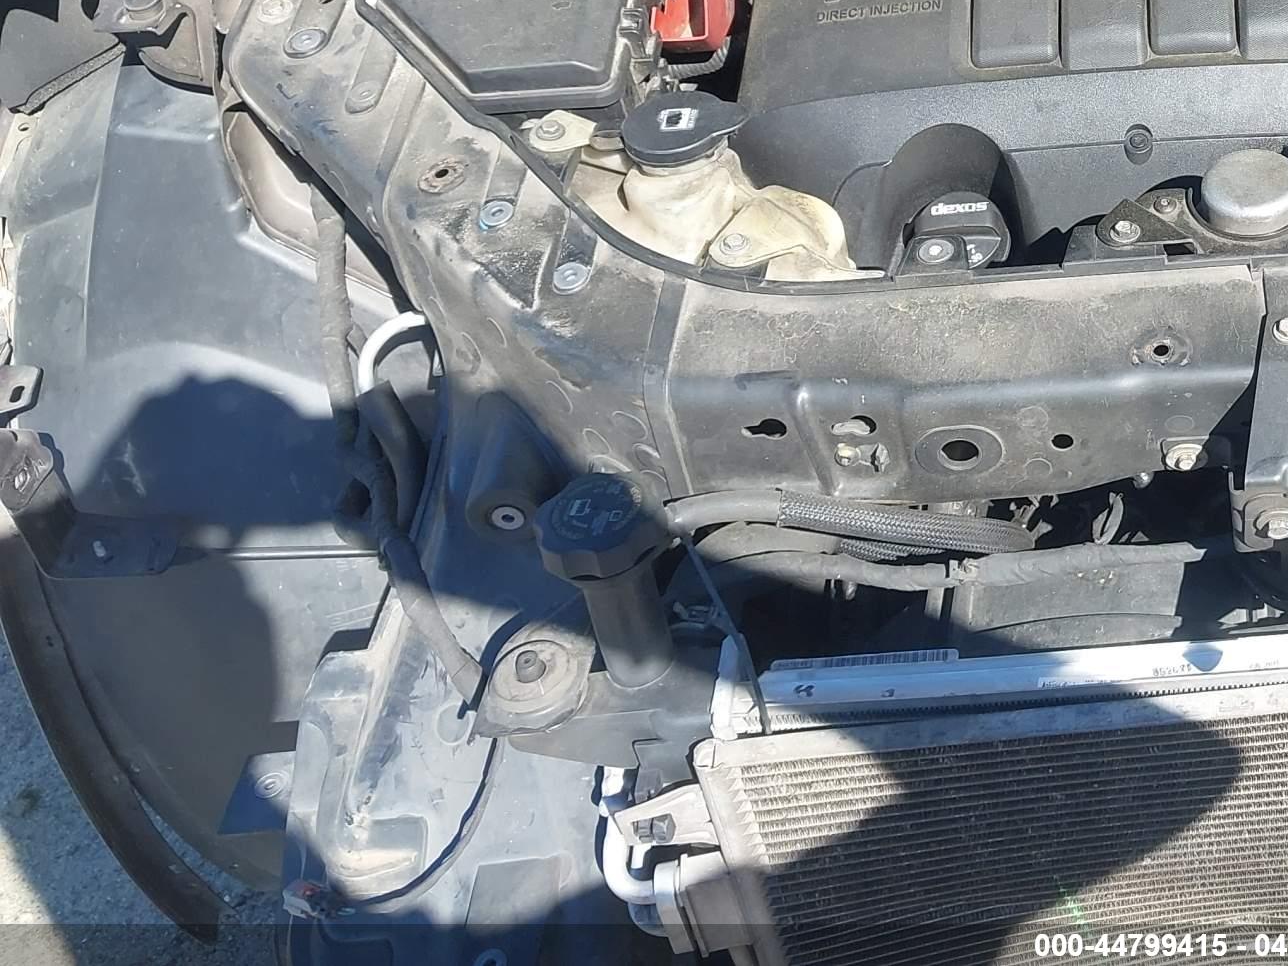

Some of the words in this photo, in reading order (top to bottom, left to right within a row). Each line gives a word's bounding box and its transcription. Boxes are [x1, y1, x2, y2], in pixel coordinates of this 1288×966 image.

[816, 8, 865, 23] DIRECT
[869, 0, 943, 17] INJECTION
[930, 201, 990, 216] dexos
